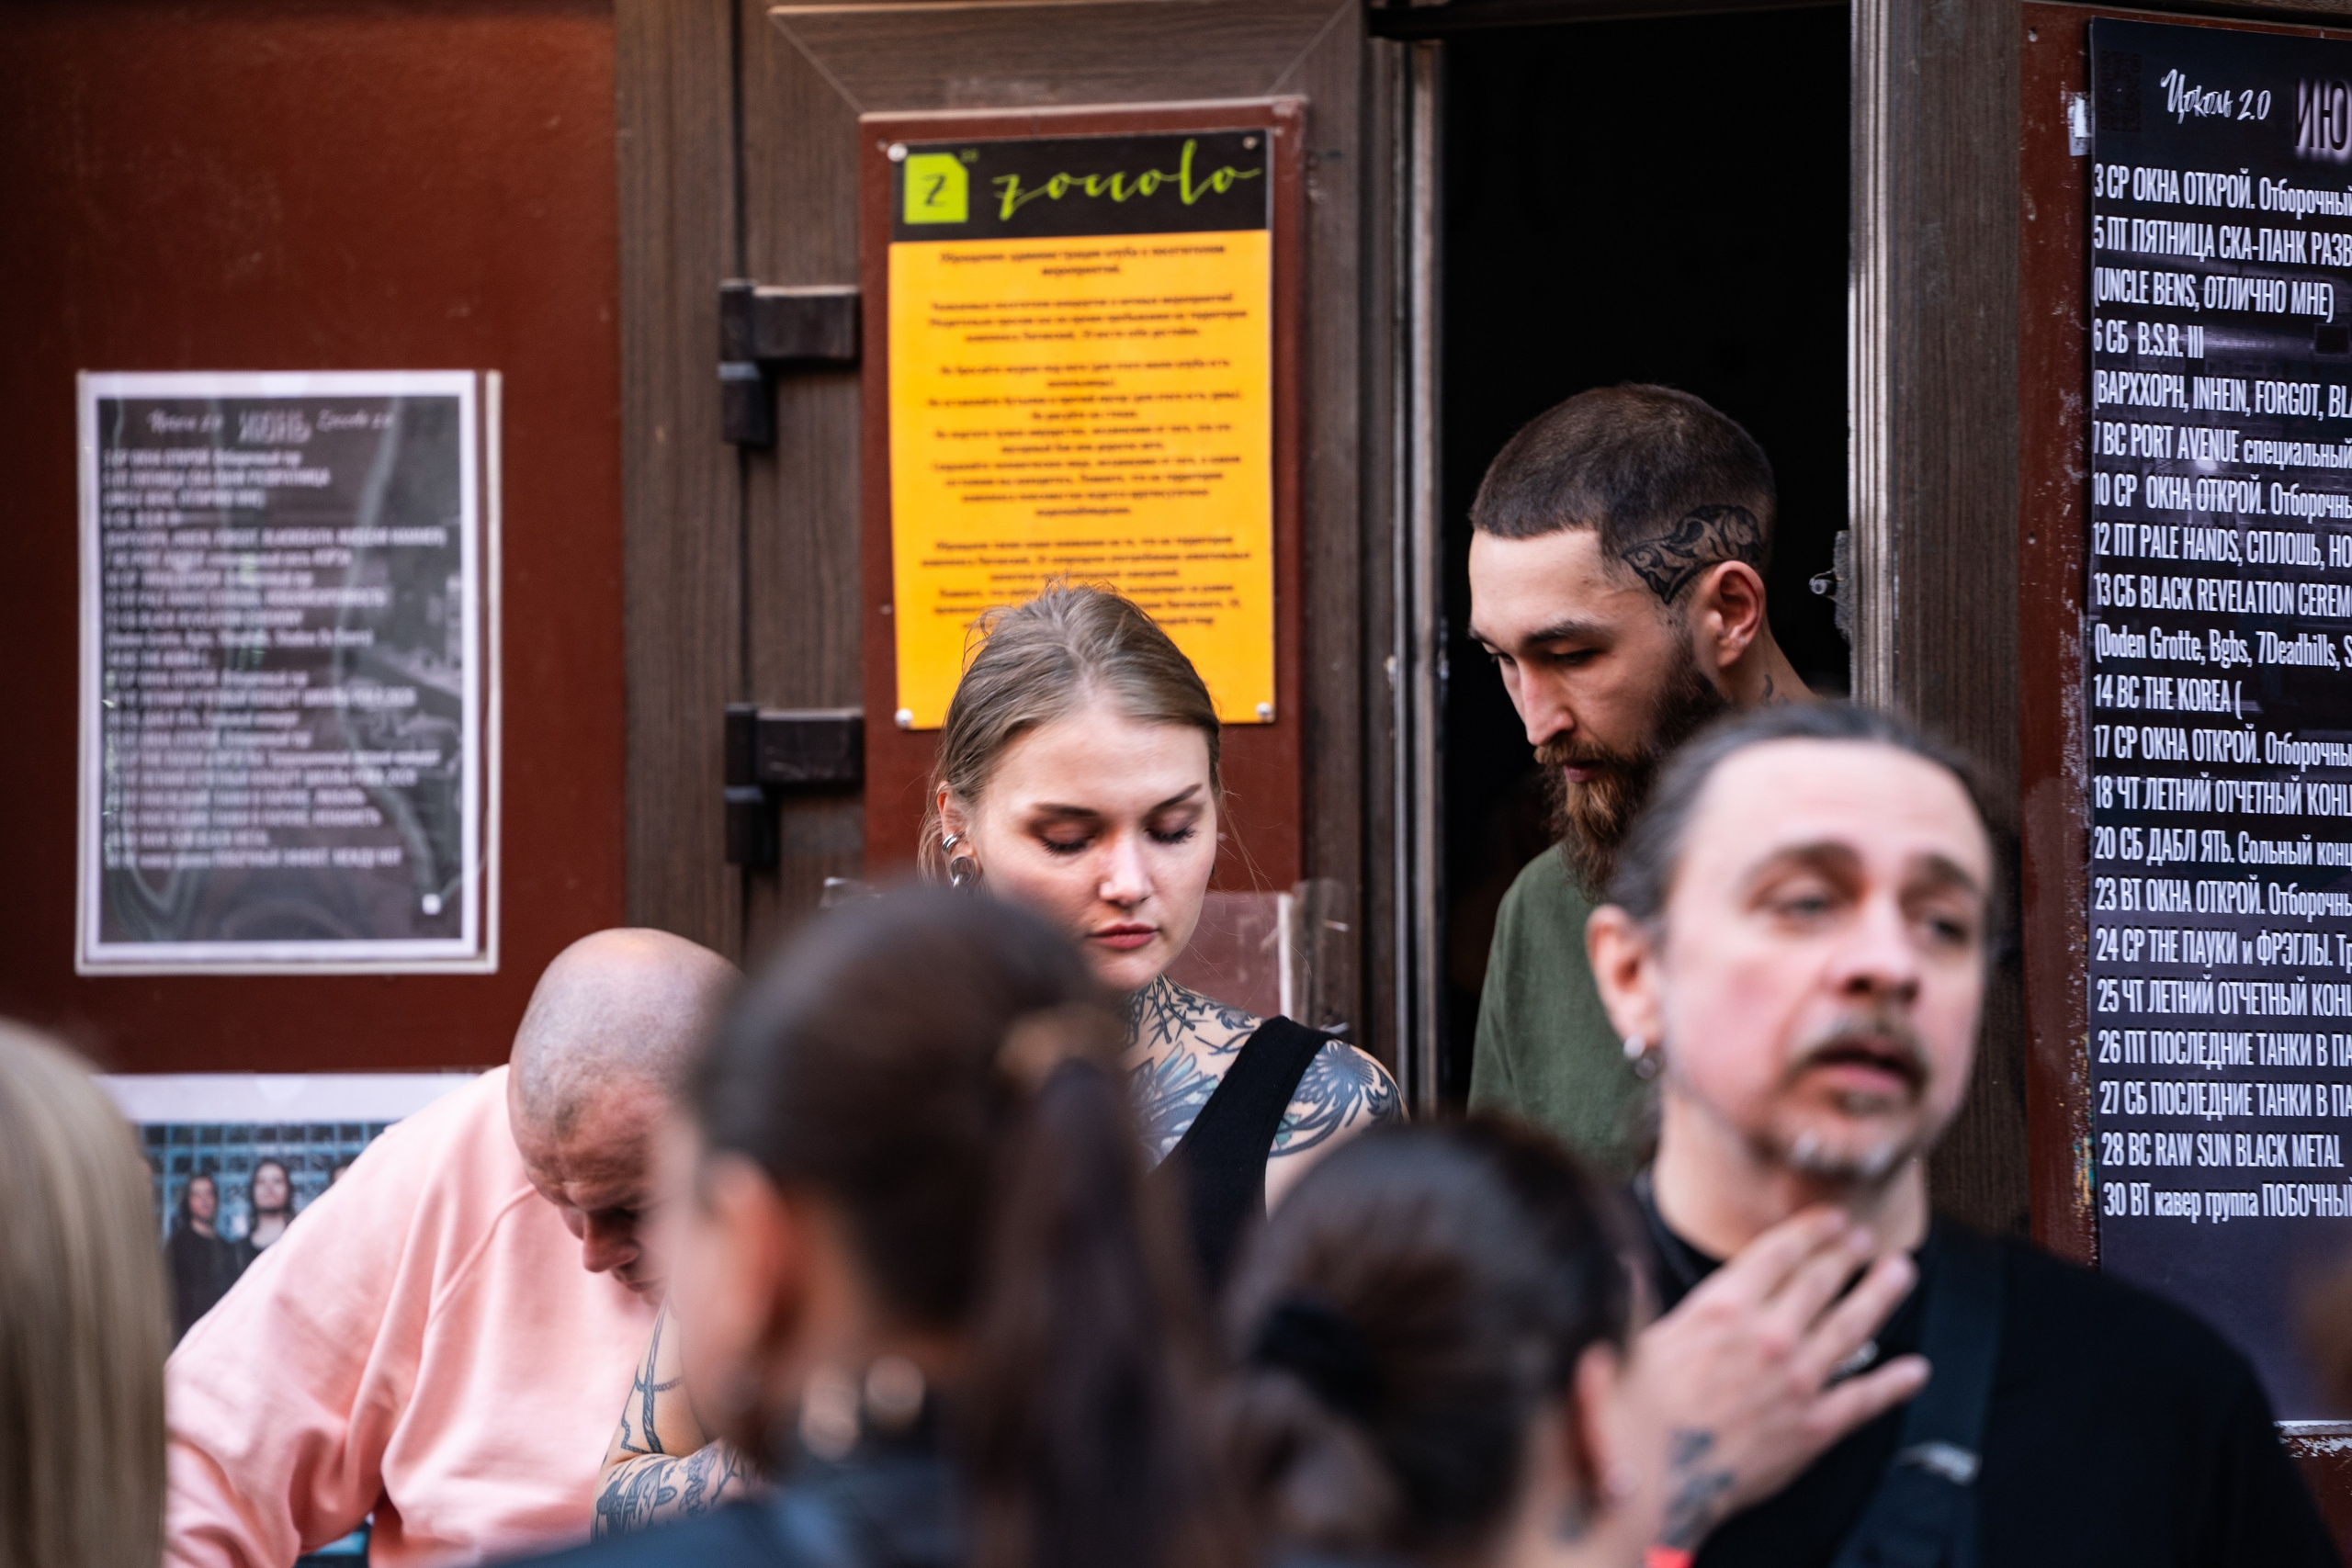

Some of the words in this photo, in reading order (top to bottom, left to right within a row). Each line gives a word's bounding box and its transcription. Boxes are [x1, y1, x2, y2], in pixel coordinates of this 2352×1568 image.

[2237, 90, 2271, 119] 2.0
[2094, 164, 2104, 197] 3
[2107, 165, 2130, 199] СР
[2133, 167, 2180, 204] ОКНА
[2184, 168, 2256, 209] ОТКРОЙ.
[2093, 216, 2104, 249] 5
[2109, 217, 2128, 250] ПТ
[2132, 219, 2214, 263] ПЯТНИЦА
[2219, 225, 2306, 264] СКА-ПАНК
[2094, 267, 2149, 307] (UNCLE
[2153, 272, 2199, 312] BENS,
[2204, 276, 2287, 313] ОТЛИЧНО
[2290, 281, 2334, 322] МНЕ)
[2093, 319, 2102, 352] 6
[2107, 321, 2129, 353] СБ
[2138, 321, 2183, 358] B.S.R.
[2188, 325, 2203, 358] III
[2193, 376, 2250, 417] INHEIN,
[2256, 380, 2324, 421] FORGOT,
[2093, 421, 2099, 454] 7
[2103, 423, 2126, 456] ВС
[2131, 424, 2174, 458] PORT
[2177, 426, 2240, 463] AVENUE
[2244, 438, 2352, 470] специальный
[2094, 472, 2110, 506] 10
[2114, 474, 2137, 507] СР
[2146, 476, 2192, 510] ОКНА
[2197, 474, 2266, 513] ОТКРОЙ.
[2093, 523, 2110, 555] 12
[2114, 524, 2135, 557] ПТ
[2140, 525, 2178, 559] PALE
[2183, 526, 2243, 567] HANDS,
[2246, 531, 2324, 570] СПЛОШЬ,
[2329, 535, 2352, 568] НО
[2094, 573, 2110, 606] 13
[2114, 574, 2135, 607] СБ
[2140, 575, 2193, 610] BLACK
[2197, 578, 2294, 615] REVELATION
[2298, 582, 2352, 617] CEREM
[2095, 624, 2146, 663] (Doden
[2150, 626, 2206, 665] Grotte,
[2209, 629, 2252, 669] Bgbs,
[2256, 631, 2340, 671] 7Deadhills,
[2094, 674, 2113, 706] 14
[2117, 675, 2140, 708] ВС
[2143, 677, 2174, 710] THE
[2177, 678, 2231, 712] KOREA
[2094, 726, 2109, 758] 17
[2114, 726, 2138, 759] СР
[2142, 728, 2189, 761] ОКНА
[2192, 724, 2261, 763] ОТКРОЙ.
[2094, 776, 2113, 808] 18
[2117, 776, 2140, 809] ЧТ
[2143, 772, 2211, 811] ЛЕТНИЙ
[2216, 775, 2302, 815] ОТЧЕТНЫЙ
[2094, 827, 2116, 860] 20
[2120, 827, 2143, 860] СБ
[2146, 829, 2196, 866] ДАБЛ
[2200, 829, 2234, 863] ЯТЬ.
[2238, 831, 2312, 865] Сольный
[2095, 877, 2116, 910] 23
[2120, 878, 2141, 911] ВТ
[2146, 879, 2192, 912] ОКНА
[2196, 874, 2266, 914] ОТКРОЙ.
[2096, 928, 2119, 961] 24
[2122, 929, 2145, 962] СР
[2183, 931, 2237, 967] ПАУКИ
[2243, 941, 2253, 964] и
[2256, 930, 2333, 966] ФРЭГЛЫ.
[2097, 978, 2119, 1011] 25
[2122, 979, 2144, 1012] ЧТ
[2147, 974, 2213, 1014] ЛЕТНИЙ
[2218, 976, 2307, 1016] ОТЧЕТНЫЙ
[2098, 1030, 2120, 1064] 26
[2124, 1031, 2146, 1064] ПТ
[2151, 1031, 2254, 1070] ПОСЛЕДНИЕ
[2256, 1032, 2312, 1066] ТАНКИ
[2316, 1034, 2327, 1066] В
[2099, 1081, 2120, 1114] 27
[2124, 1081, 2147, 1115] СБ
[2151, 1082, 2253, 1121] ПОСЛЕДНИЕ
[2256, 1084, 2312, 1116] ТАНКИ
[2316, 1085, 2327, 1117] В
[2101, 1133, 2124, 1166] 28
[2128, 1133, 2151, 1166] ВС
[2155, 1133, 2193, 1166] RAW
[2197, 1134, 2231, 1167] SUN
[2235, 1134, 2289, 1167] BLACK
[2292, 1134, 2344, 1168] METAL
[2103, 1182, 2126, 1216] 30
[2130, 1183, 2151, 1216] ВТ
[2154, 1191, 2201, 1224] кавер
[2205, 1191, 2258, 1224] группа
